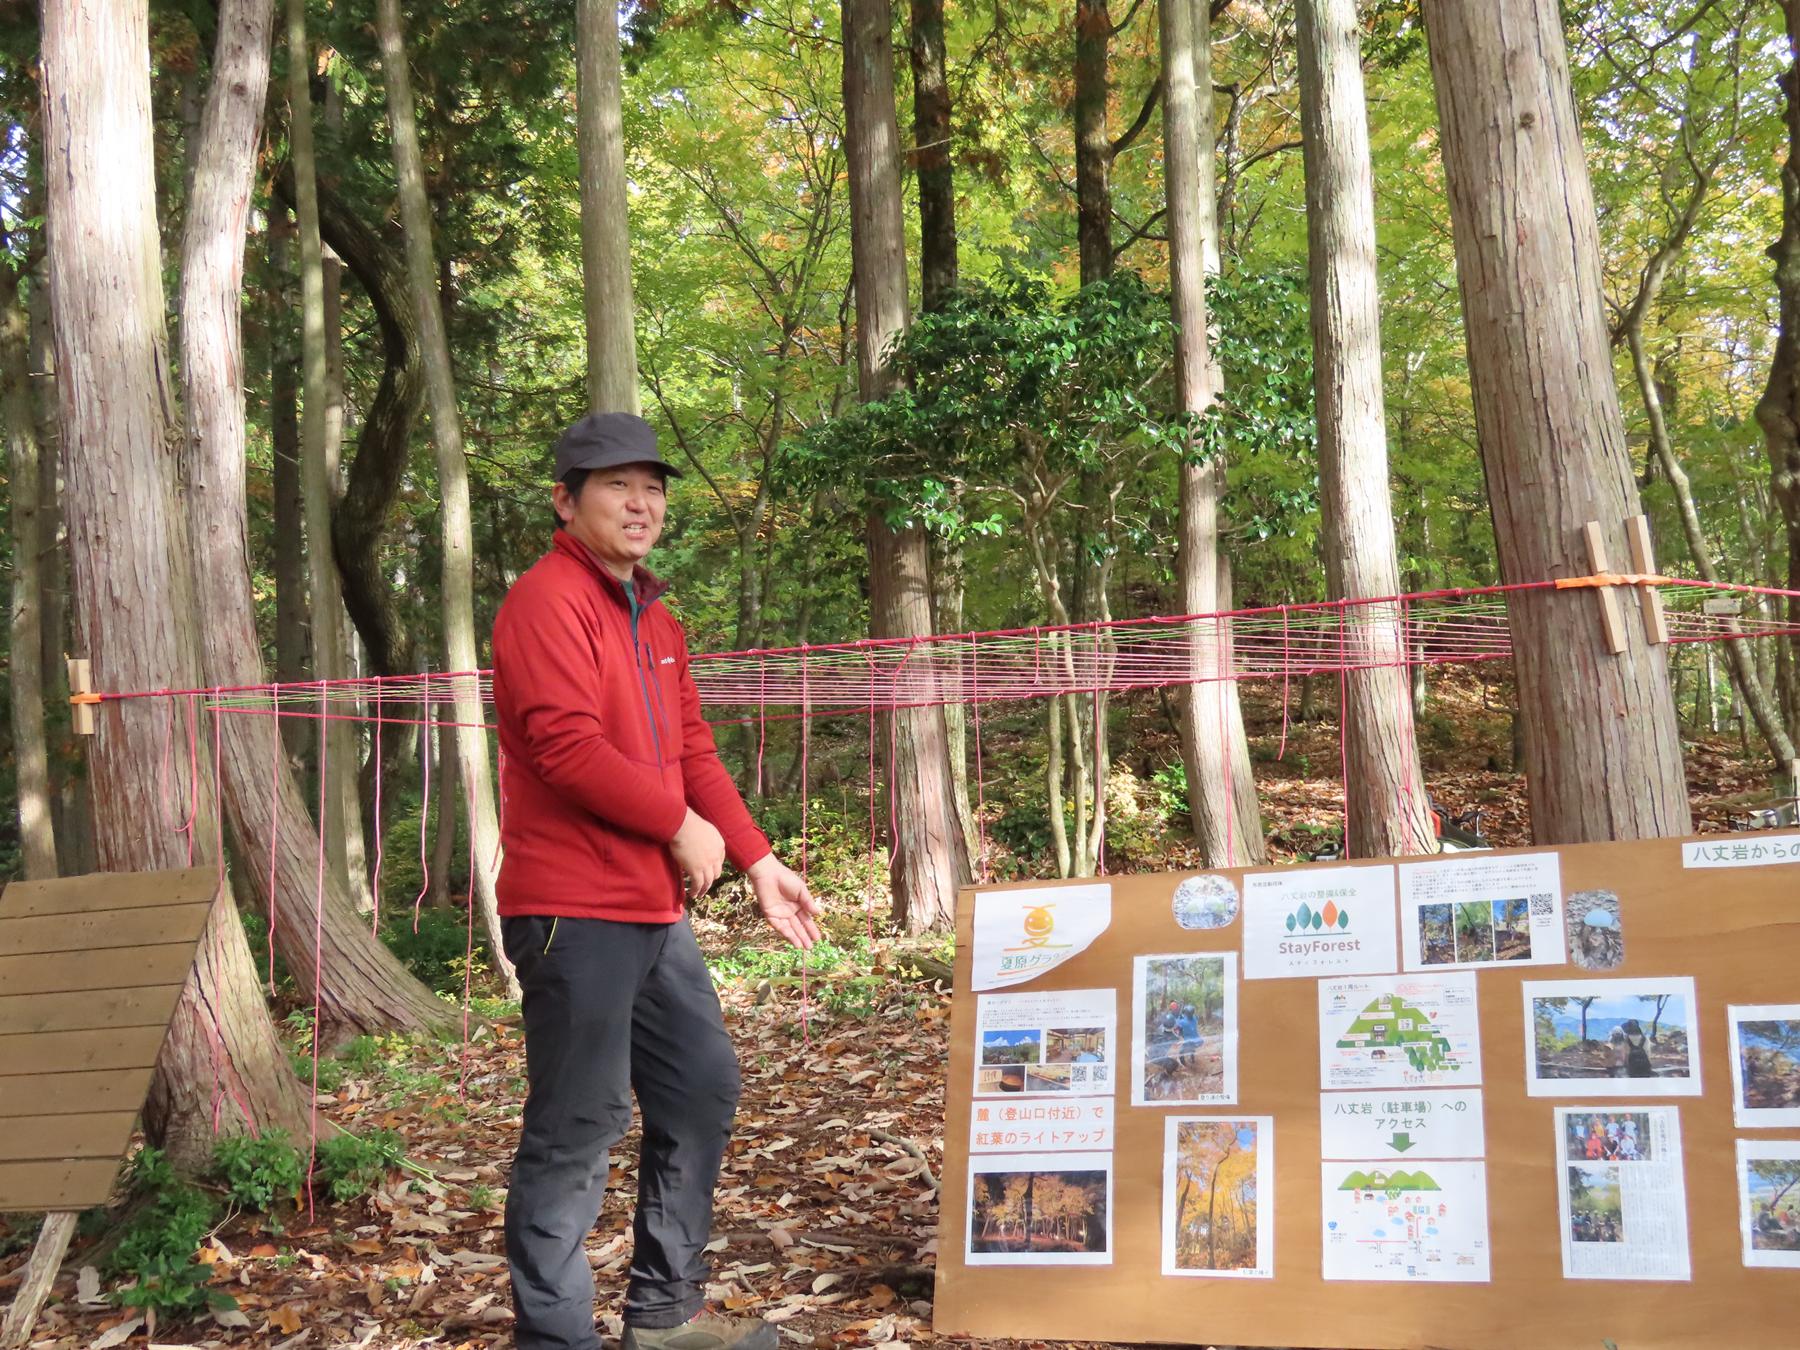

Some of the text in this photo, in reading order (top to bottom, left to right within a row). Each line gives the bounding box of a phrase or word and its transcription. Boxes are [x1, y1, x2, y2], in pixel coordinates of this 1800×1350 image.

[1279, 939, 1361, 956] StayForest
[1375, 1118, 1427, 1130] アクセス
[976, 1128, 1105, 1146] 紅葉のライトアップ
